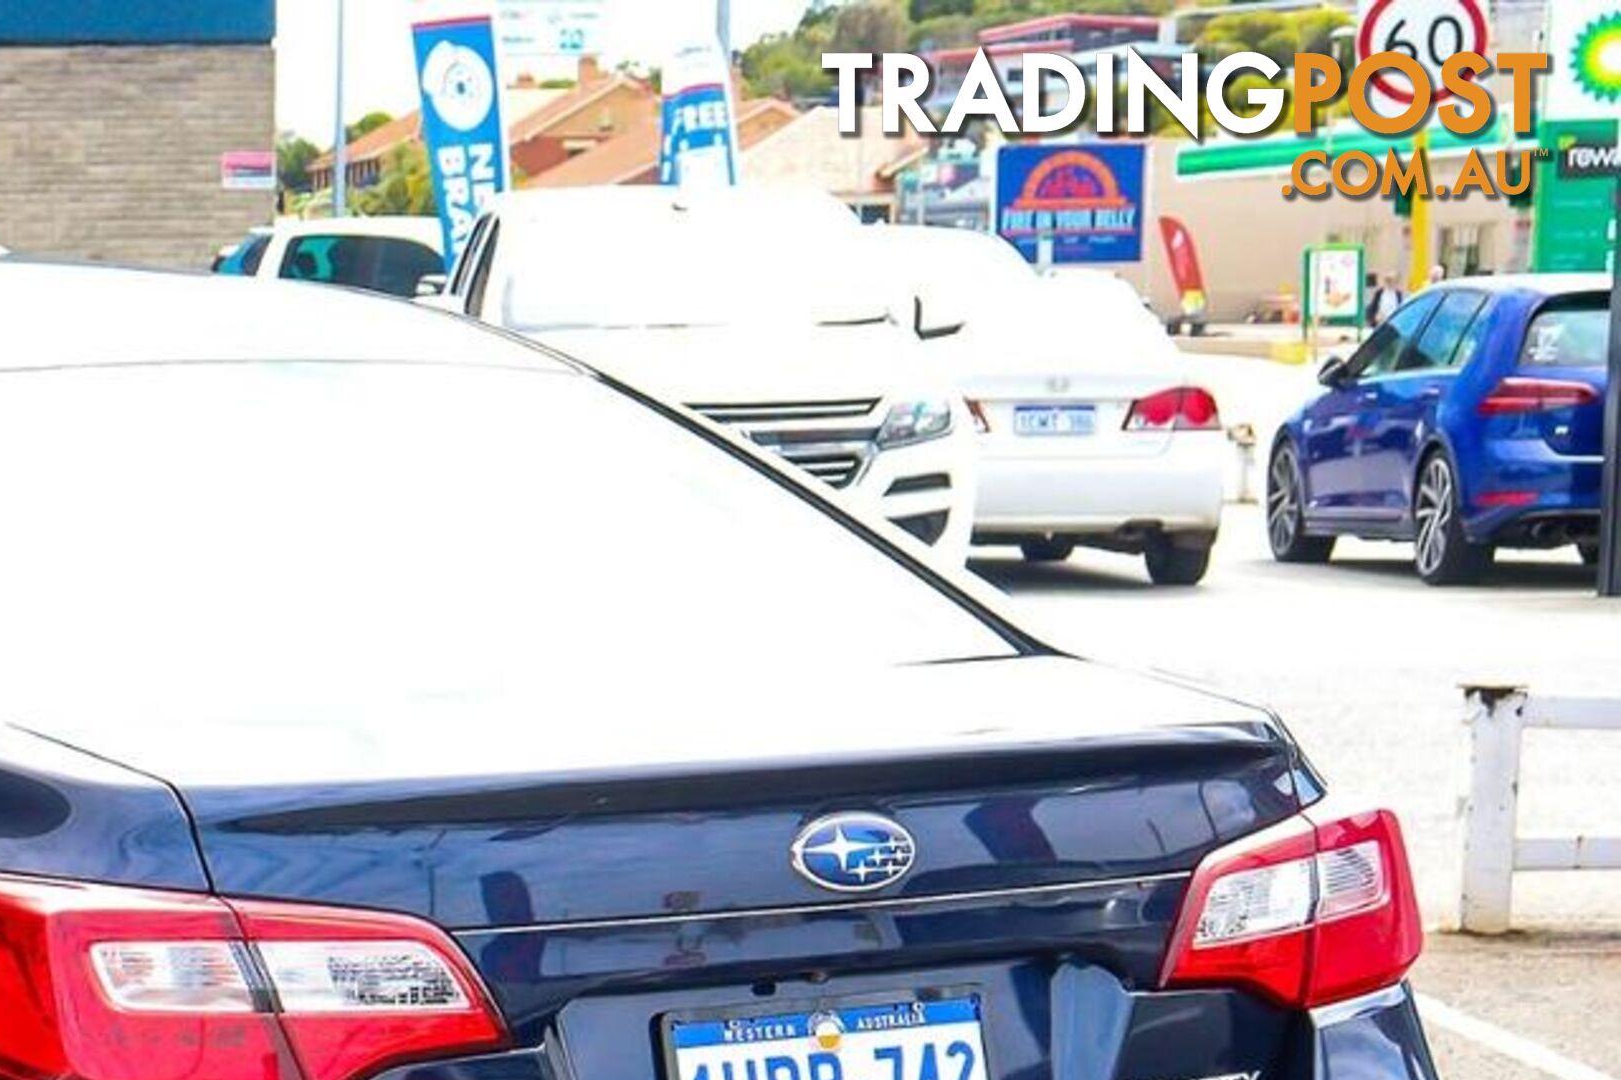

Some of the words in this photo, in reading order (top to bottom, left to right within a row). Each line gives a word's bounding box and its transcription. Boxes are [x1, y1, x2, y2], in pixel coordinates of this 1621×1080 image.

[1384, 15, 1463, 67] 60
[724, 1026, 796, 1042] WESTERN
[857, 1011, 926, 1030] AUSTRALIA
